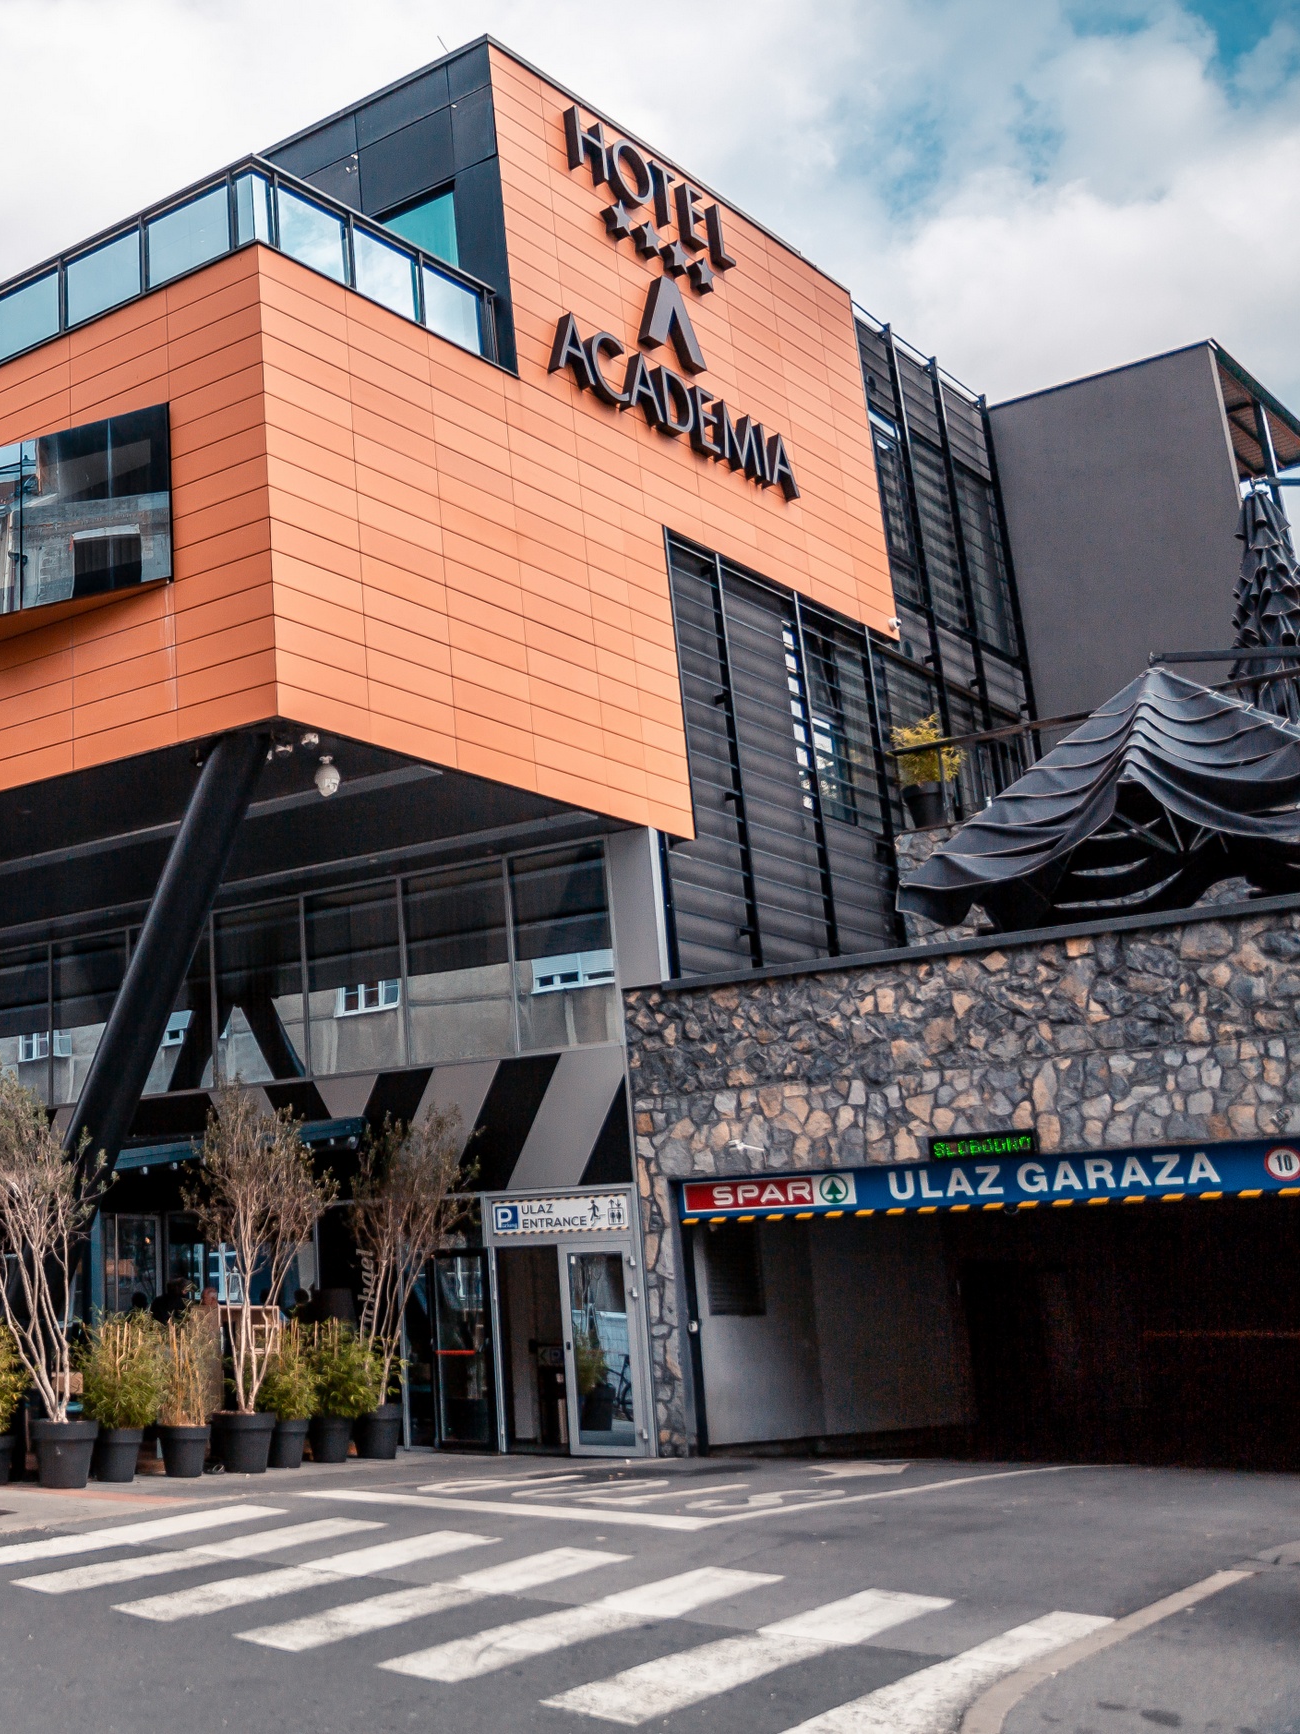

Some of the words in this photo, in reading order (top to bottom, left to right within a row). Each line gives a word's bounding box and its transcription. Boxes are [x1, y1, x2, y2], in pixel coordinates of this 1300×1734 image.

[562, 104, 737, 272] HOTEL
[547, 311, 801, 501] ACADEMIA
[887, 1165, 1004, 1200] ULAZ
[1016, 1152, 1221, 1193] GARAZA
[1275, 1153, 1293, 1172] 10
[521, 1203, 554, 1215] ULAZ
[712, 1181, 812, 1206] SPAR
[522, 1215, 587, 1229] ENTRANCE
[417, 1474, 847, 1511] STOP
